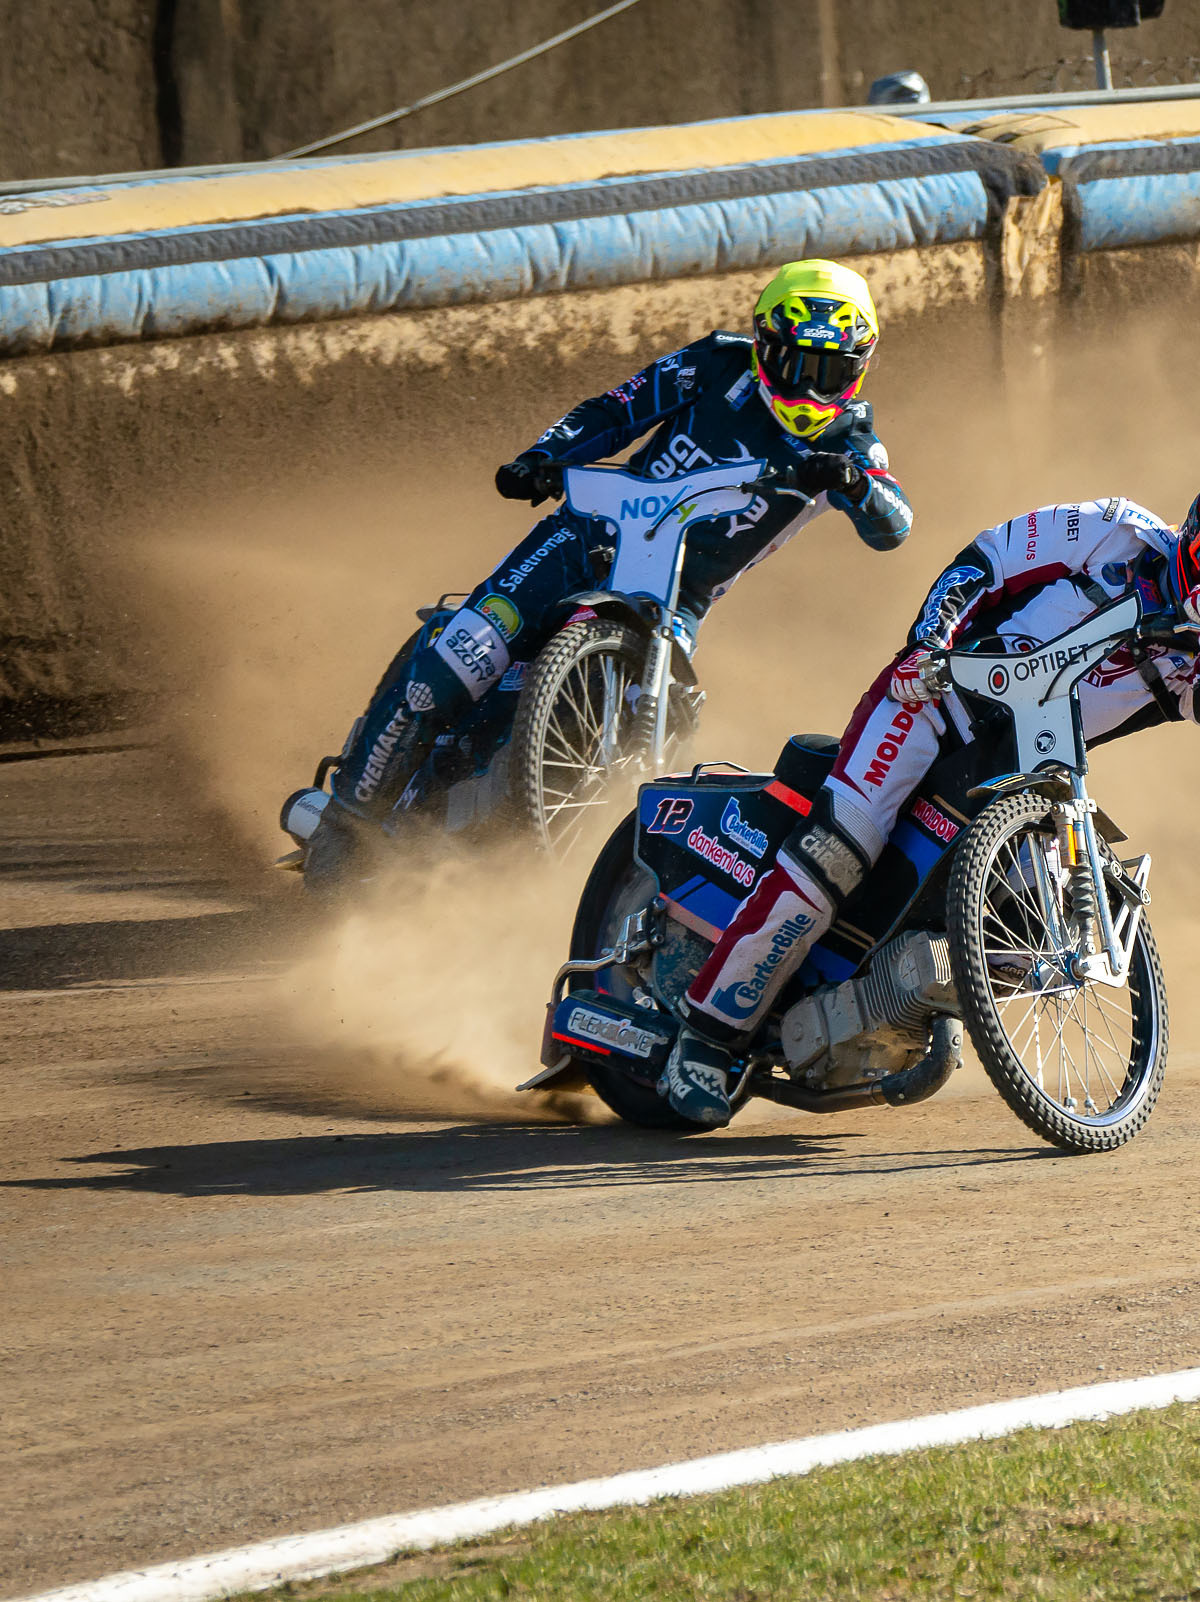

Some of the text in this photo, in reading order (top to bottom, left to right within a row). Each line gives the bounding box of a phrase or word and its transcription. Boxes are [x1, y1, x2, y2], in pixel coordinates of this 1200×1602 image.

[1027, 511, 1040, 539] kemi
[1066, 505, 1080, 542] TIBET
[499, 527, 577, 593] Saletromag
[1014, 643, 1088, 681] OPTIBET
[354, 708, 409, 802] CHEMART
[647, 798, 694, 834] 12
[729, 814, 768, 852] BarkerBille
[911, 800, 959, 843] MOLDOW
[687, 826, 739, 874] dankemi
[732, 860, 756, 888] a/s
[737, 913, 811, 1001] BarkerBille
